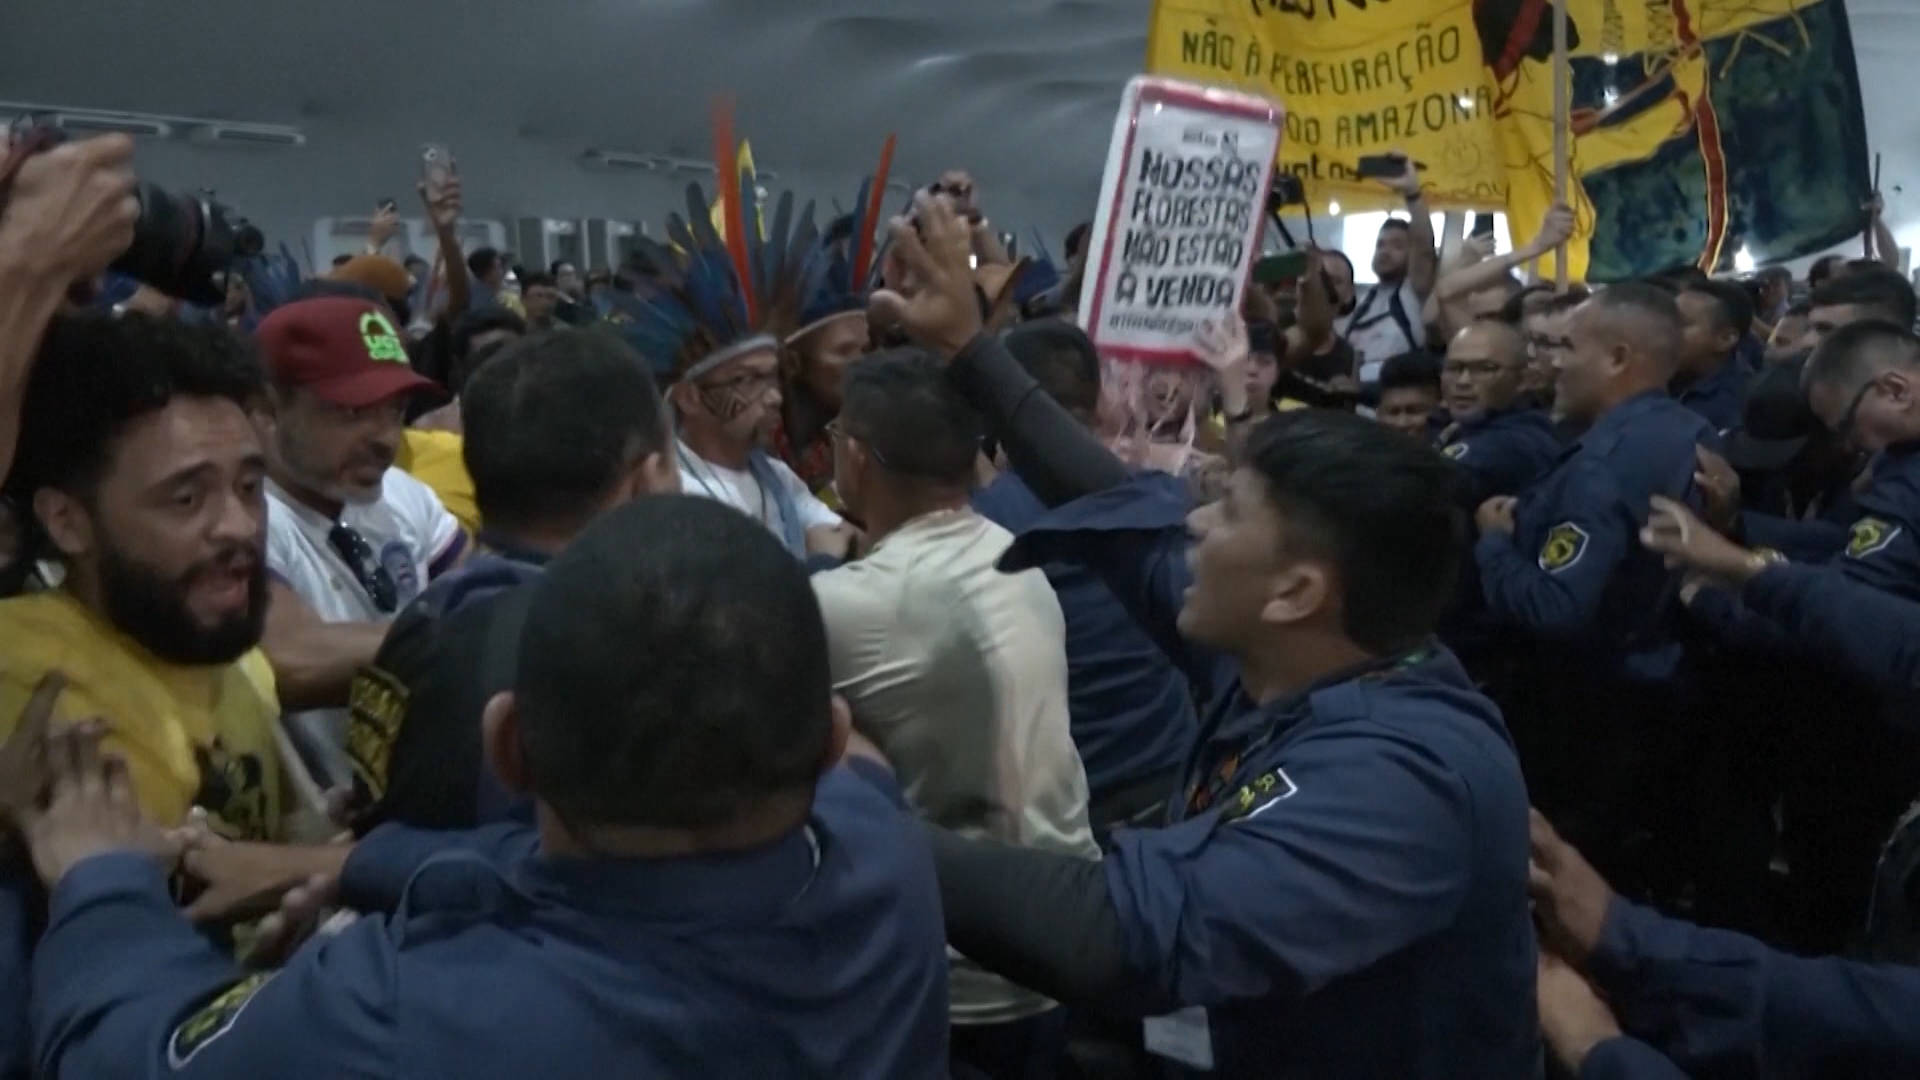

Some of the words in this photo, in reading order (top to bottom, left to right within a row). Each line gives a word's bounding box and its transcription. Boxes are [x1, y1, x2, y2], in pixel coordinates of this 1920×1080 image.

[1182, 17, 1235, 71] NÃO
[1270, 22, 1461, 95] PERFURAÇÃO
[1139, 150, 1261, 197] NOSSAS
[1131, 187, 1250, 233] FLORESTAS
[1122, 228, 1170, 267] NÃO
[1174, 234, 1243, 270] ESTÃO
[1147, 273, 1235, 309] VENDA
